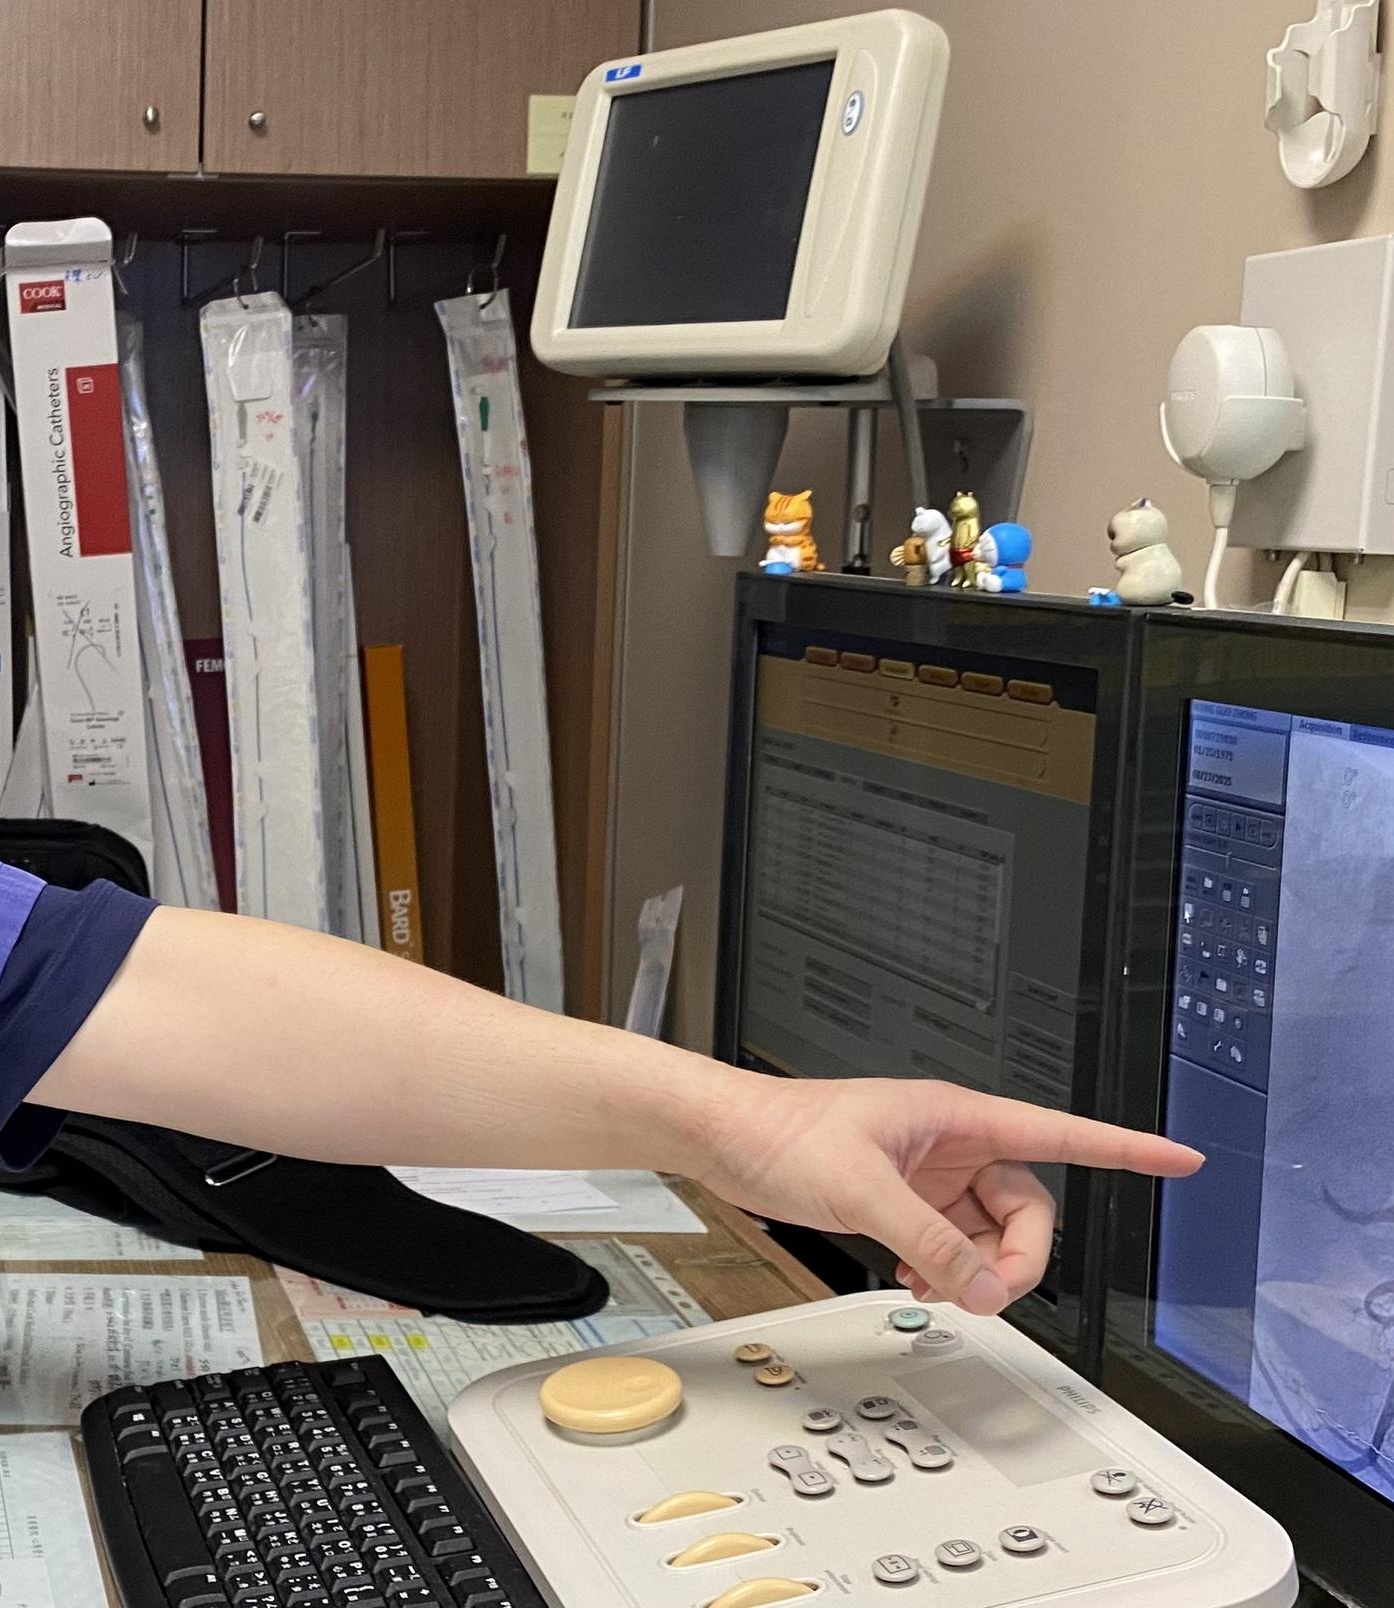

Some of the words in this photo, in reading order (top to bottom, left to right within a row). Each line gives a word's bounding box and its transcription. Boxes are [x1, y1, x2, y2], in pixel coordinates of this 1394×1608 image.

[23, 286, 62, 299] COOK
[47, 368, 65, 446] Catheters
[52, 450, 75, 558] Angiographic
[195, 658, 226, 673] FEM
[389, 890, 411, 945] BARD
[1056, 1386, 1101, 1415] PHILIPS
